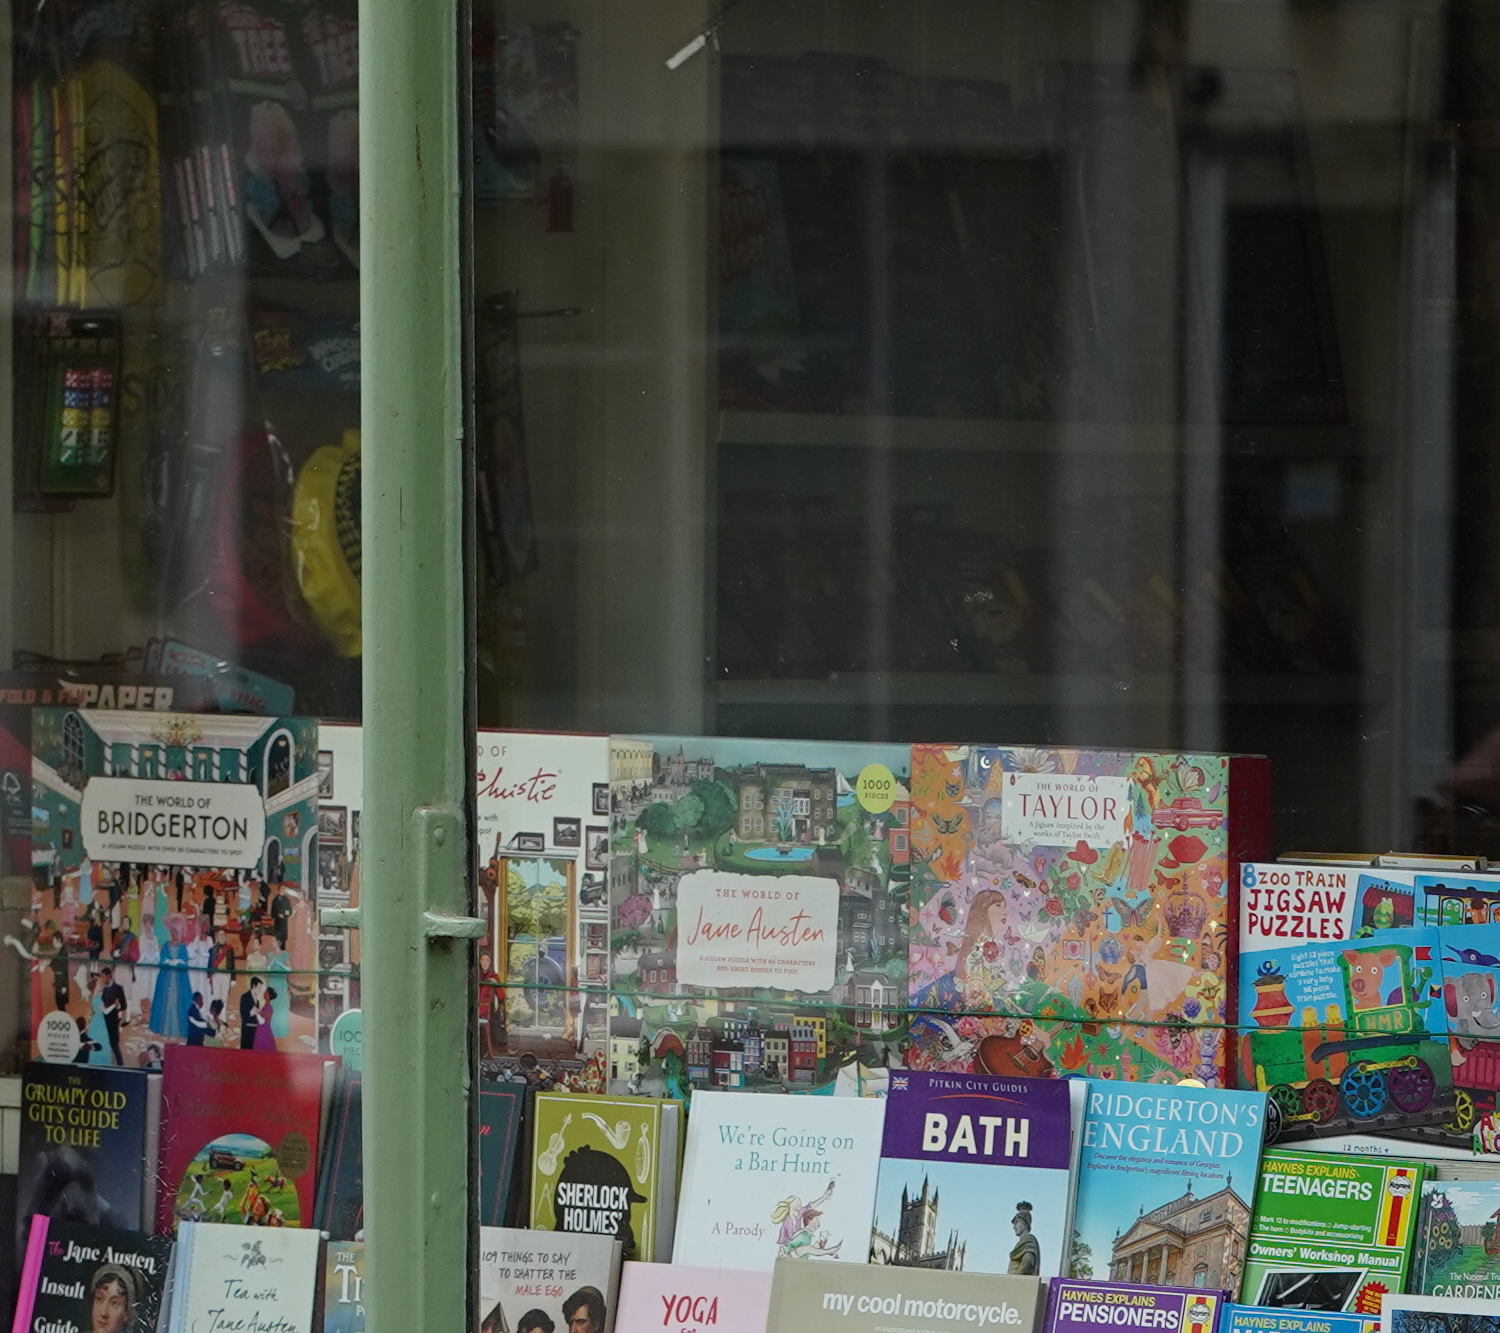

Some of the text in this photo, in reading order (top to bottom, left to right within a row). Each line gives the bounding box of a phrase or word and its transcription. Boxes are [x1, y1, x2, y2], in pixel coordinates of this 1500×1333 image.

[135, 795, 211, 809] THE WORLD OF
[1019, 792, 1118, 822] TAYLOR
[98, 810, 248, 841] BRIDGERTON
[1247, 889, 1346, 915] JIGSAW
[1248, 912, 1345, 939] PUZZLES
[922, 1112, 1030, 1158] BATH
[1084, 1121, 1242, 1159] ENGLAND
[1261, 1173, 1373, 1201] TEENAGERS
[662, 1294, 718, 1326] YOGA
[1059, 1302, 1179, 1330] PENSIONERS
